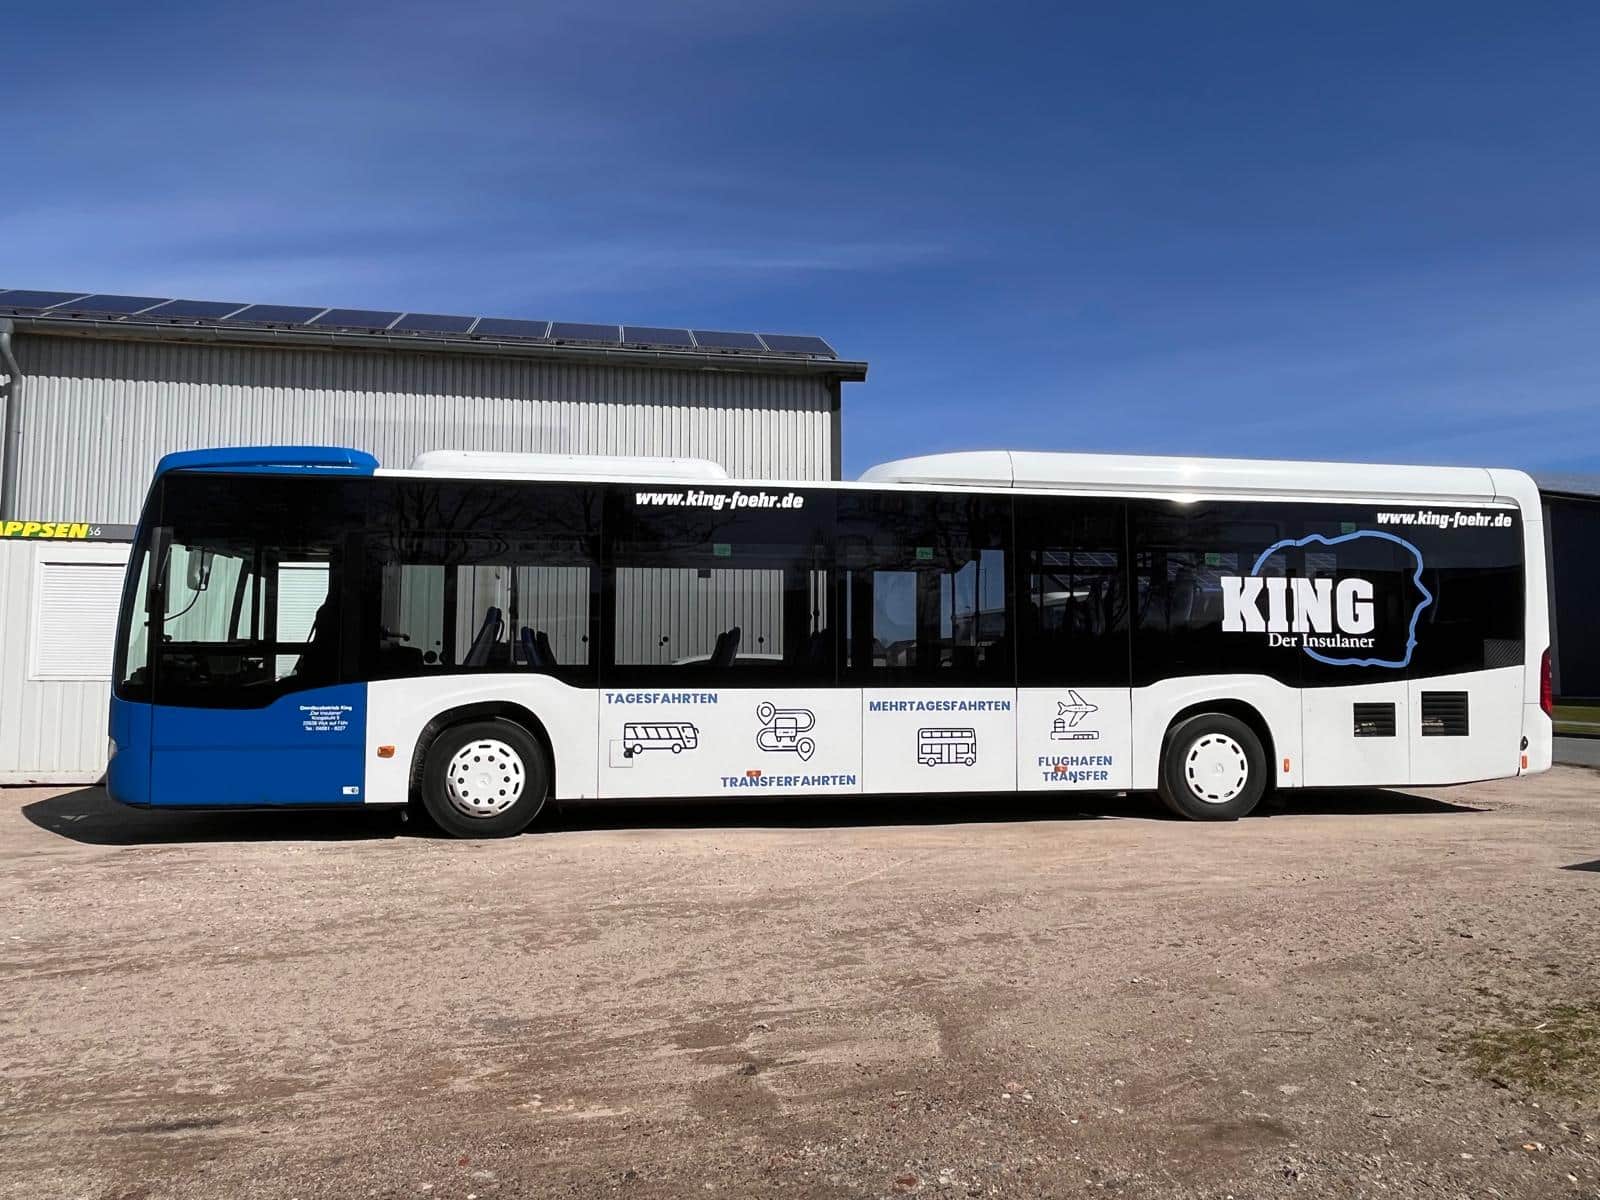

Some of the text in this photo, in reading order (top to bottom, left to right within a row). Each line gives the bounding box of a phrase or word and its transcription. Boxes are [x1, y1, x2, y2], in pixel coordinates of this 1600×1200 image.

[635, 490, 804, 511] www.king-foehr.de
[1376, 511, 1513, 529] www.king-foehr.de
[0, 521, 89, 538] PPSEN
[1220, 576, 1375, 635] KING
[1268, 633, 1375, 649] Der Insulaner
[605, 693, 718, 705] TAGESFAHRTEN
[869, 700, 1011, 712] MEHRTAGESFAHRTEN
[1038, 756, 1113, 768] FLUGHAFEN
[721, 774, 857, 788] TRANSFERFAHRTEN
[1042, 770, 1109, 782] TRANSFER
